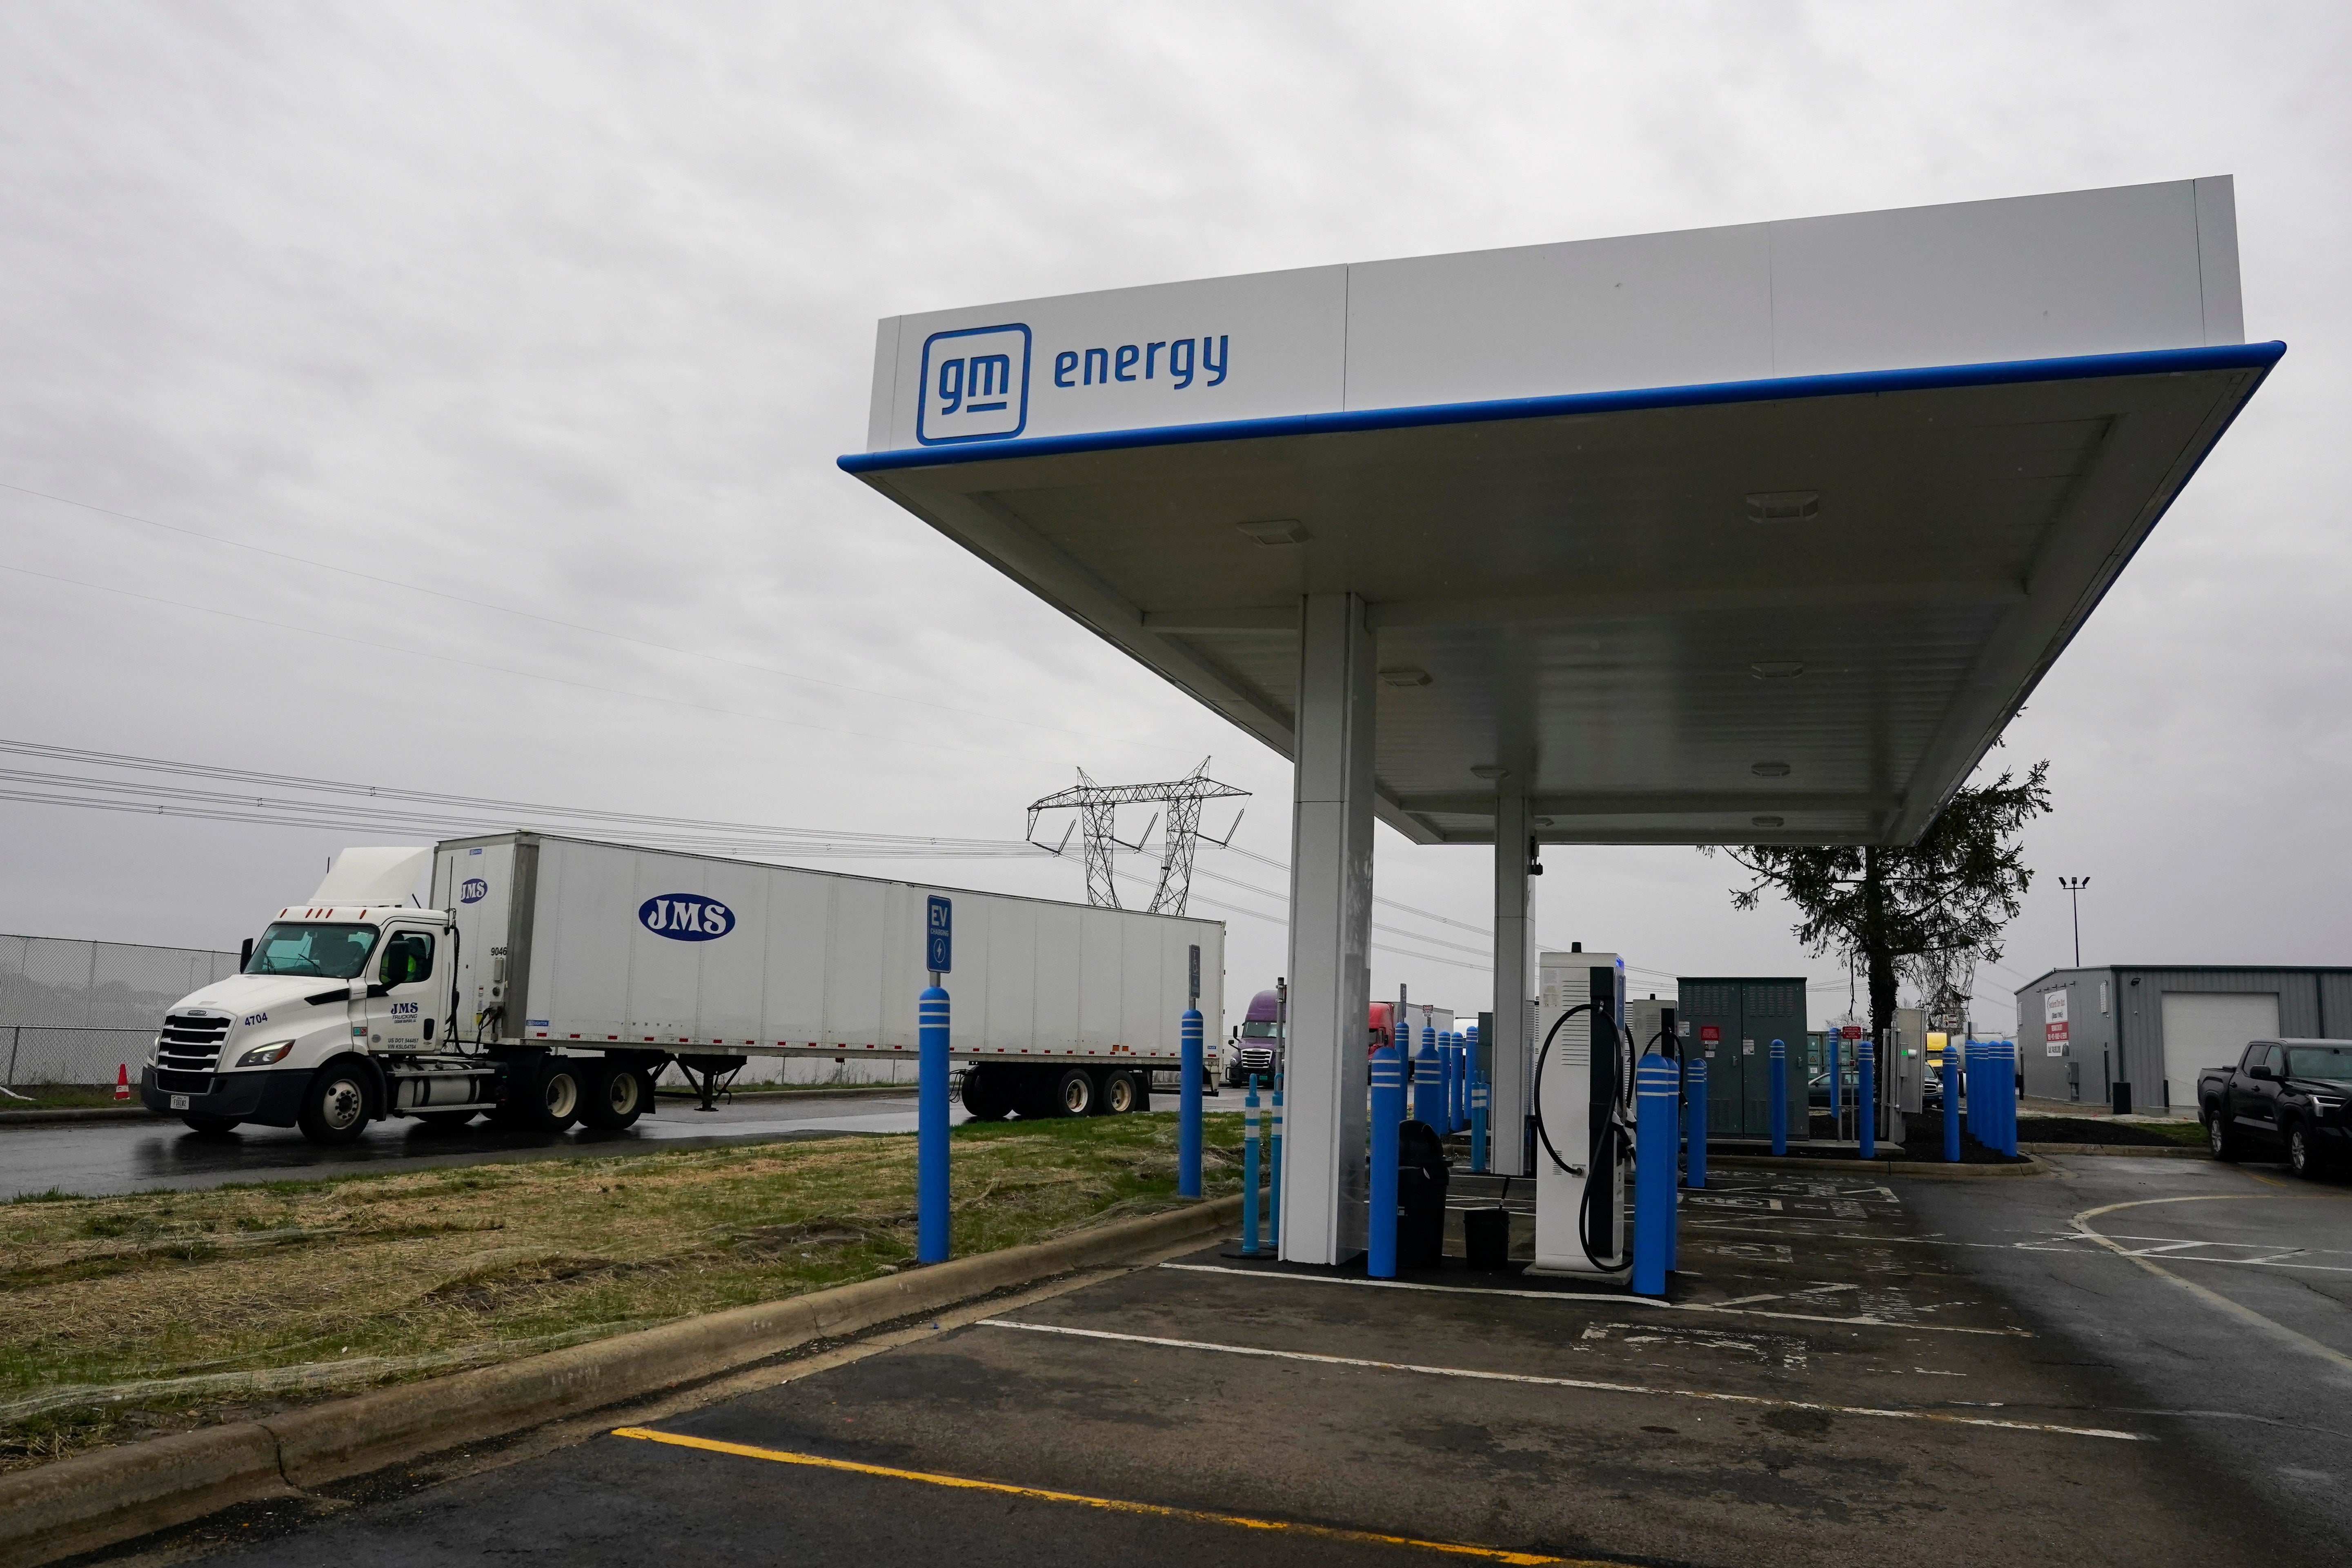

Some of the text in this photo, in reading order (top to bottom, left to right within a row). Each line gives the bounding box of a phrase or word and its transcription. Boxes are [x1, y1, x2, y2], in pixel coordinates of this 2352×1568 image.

[939, 335, 1229, 416] gm energy
[461, 881, 485, 900] JMS
[647, 899, 727, 935] JMS
[931, 905, 948, 927] EV
[930, 928, 949, 937] CHARGING
[491, 947, 507, 956] 9046
[391, 1002, 418, 1014] JMS
[245, 1012, 268, 1026] 4704
